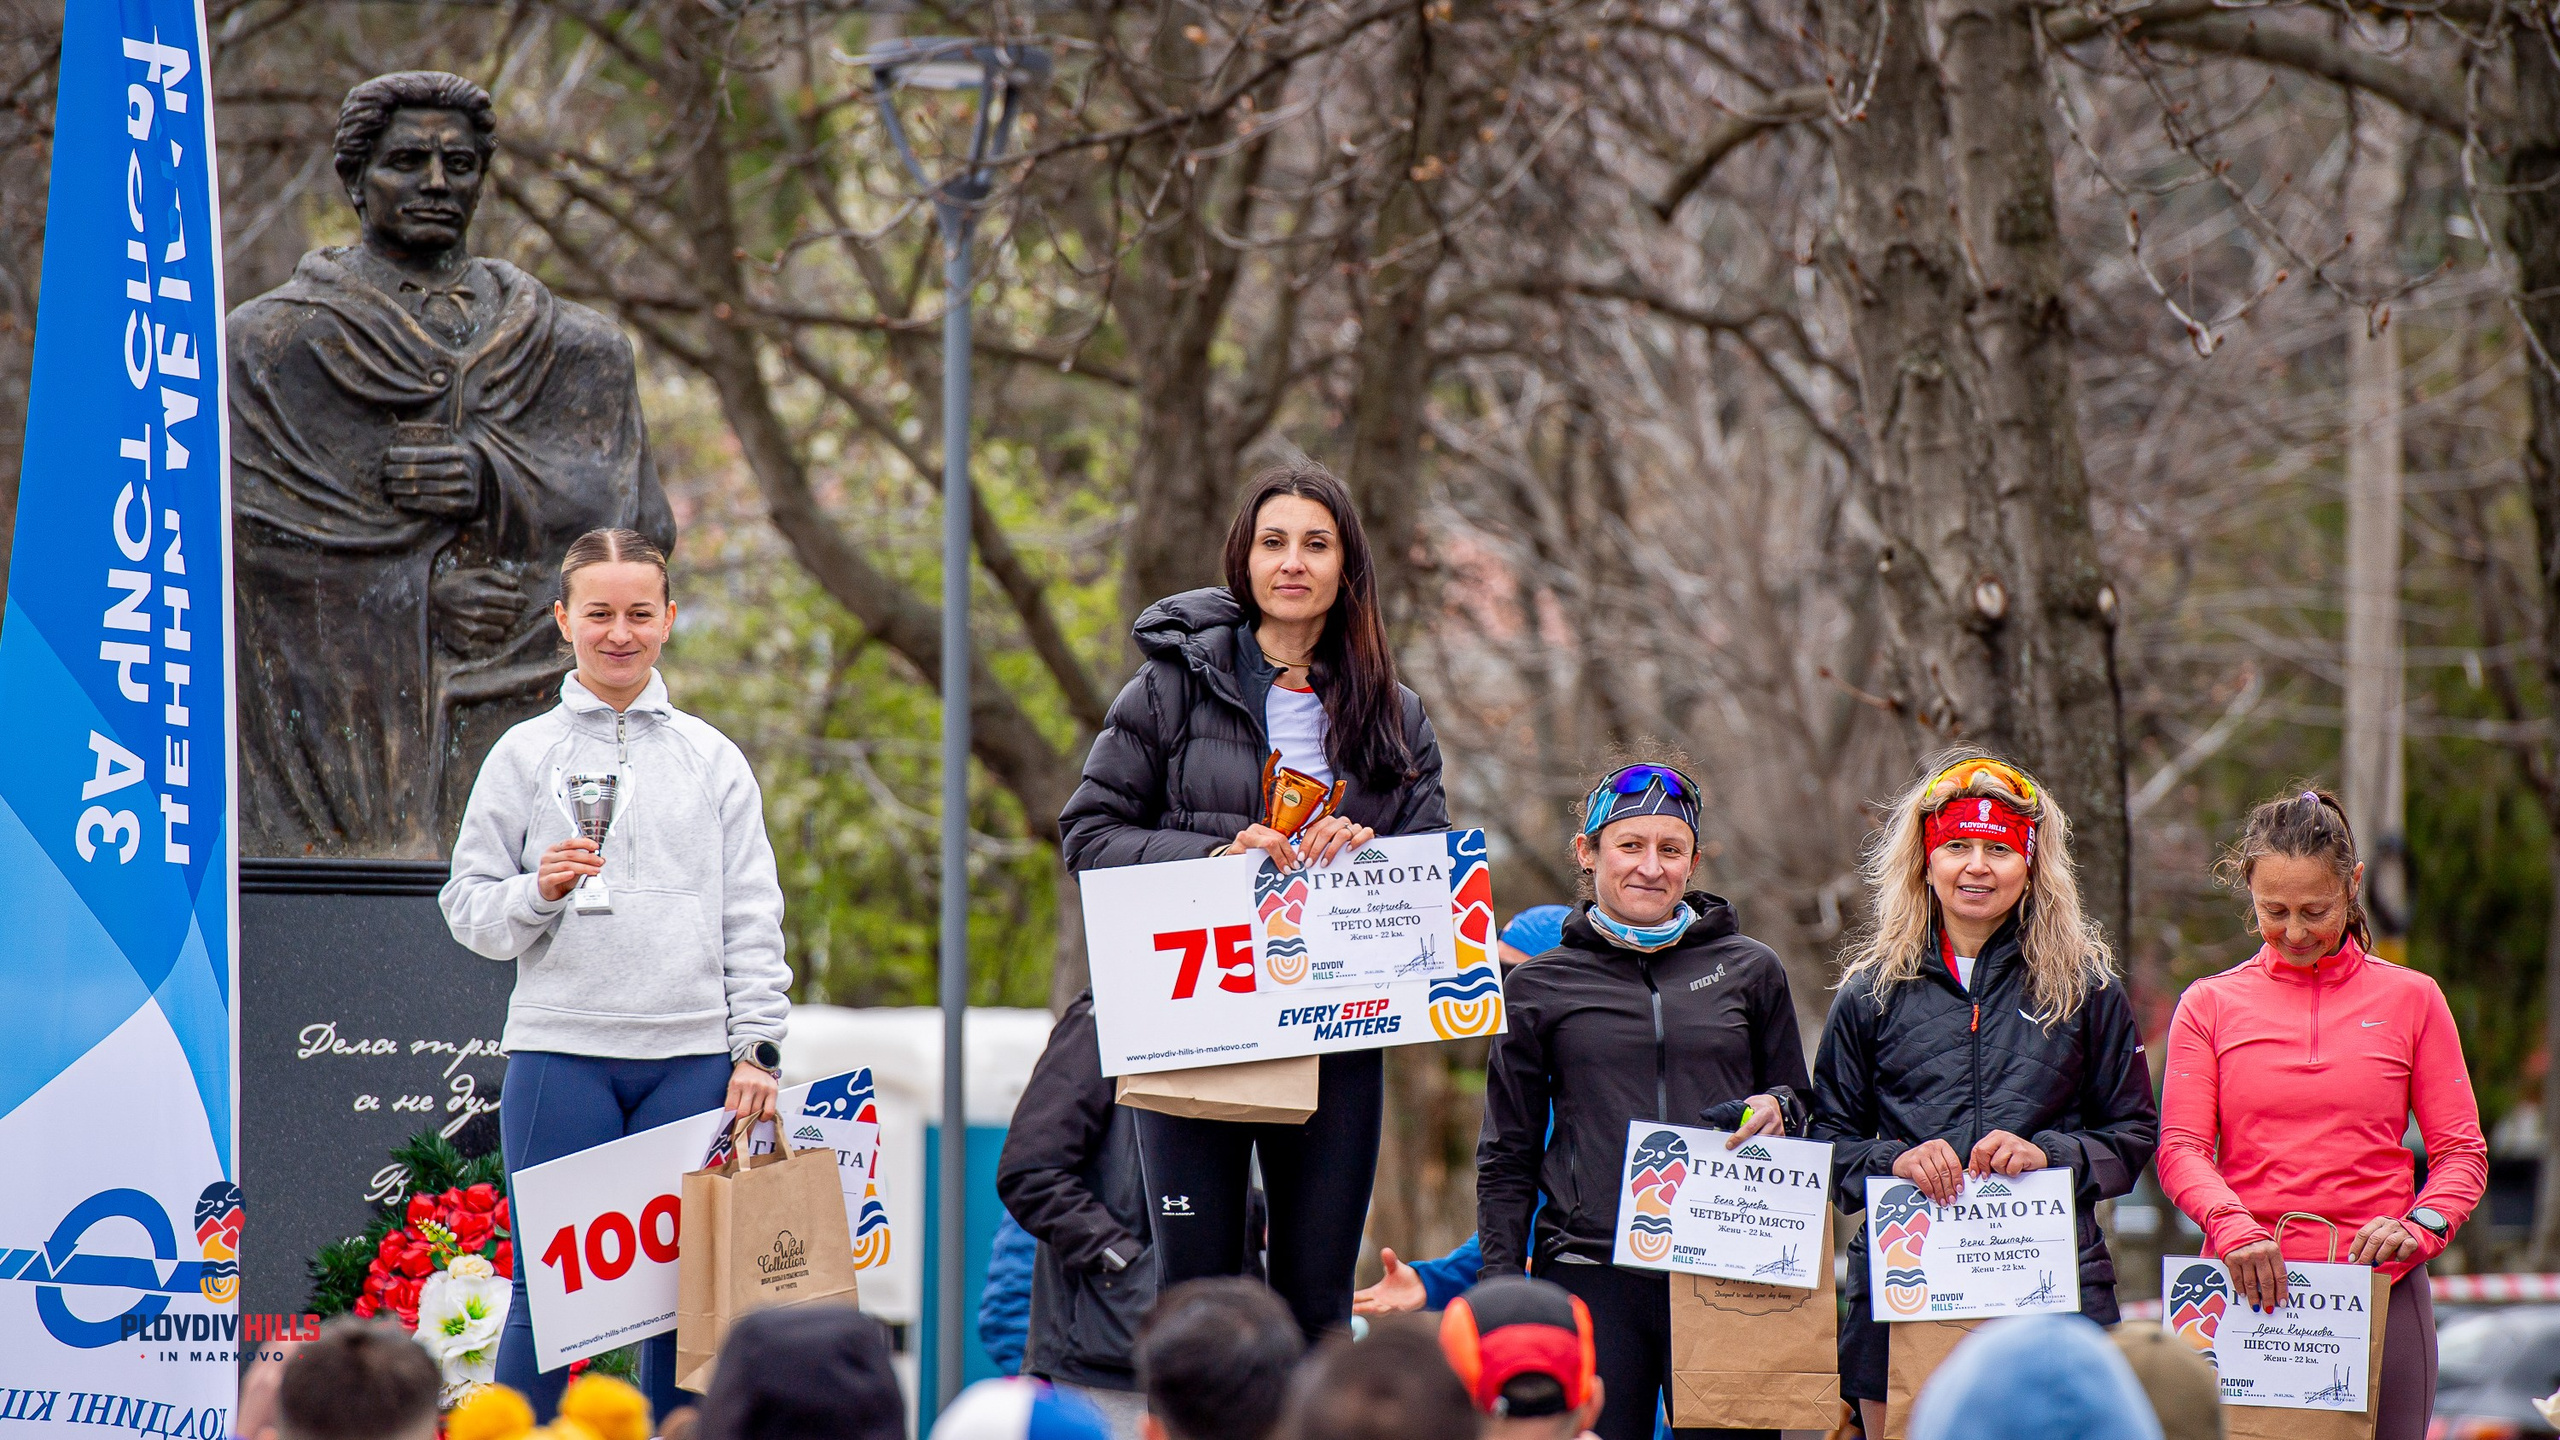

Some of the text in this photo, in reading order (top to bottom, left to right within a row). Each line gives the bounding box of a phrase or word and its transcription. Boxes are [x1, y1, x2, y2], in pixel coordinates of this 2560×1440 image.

[1959, 821, 1989, 829] PLOVDIV
[1989, 823, 2007, 833] HILLS
[1313, 864, 1442, 890] ГРАМОТА
[1332, 915, 1421, 931] ТРЕТО МЯСТО
[1350, 933, 1373, 941] Жени
[1380, 931, 1390, 939] 22
[1152, 923, 1257, 1001] 75
[1311, 960, 1344, 971] PLOVDIV
[1312, 971, 1334, 980] HILLS
[1278, 998, 1390, 1028] EVERY STEP
[1313, 1015, 1401, 1041] MATTERS
[297, 1021, 510, 1080] Дела тря
[1126, 1041, 1259, 1062] www.plovdiv-hills-in-markovo.com
[353, 1094, 380, 1112] а
[392, 1094, 435, 1112] не
[1692, 1158, 1822, 1189] ГРАМОТА
[1744, 1185, 1757, 1193] НА
[1689, 1207, 1805, 1231] ЧЕТВЪРТО МЯСТО
[1935, 1199, 2066, 1223] ГРАМОТА
[1718, 1224, 1741, 1234] Жени
[1748, 1228, 1758, 1236] 22
[541, 1193, 682, 1295] 100
[773, 1237, 806, 1260] Wool
[1673, 1244, 1707, 1256] PLOVDIV
[757, 1254, 807, 1274] Collection
[1672, 1254, 1694, 1265] HILLS
[1956, 1248, 2040, 1264] ПЕТО МЯСТО
[1971, 1265, 1995, 1274] Жени
[2002, 1264, 2011, 1272] 22
[1930, 1292, 1964, 1302] PLOVDIV
[2231, 1289, 2364, 1313] ГМОТА
[1931, 1302, 1953, 1312] HILLS
[2286, 1312, 2300, 1320] НА
[559, 1310, 677, 1354] www.plovdiv-hills-in-markovo.com
[2243, 1339, 2341, 1355] ШЕСТО МЯСТО
[2263, 1354, 2287, 1363] Жени
[2294, 1355, 2304, 1363] 22
[2220, 1377, 2255, 1388] PLOVDIV
[2220, 1387, 2243, 1397] HILLS
